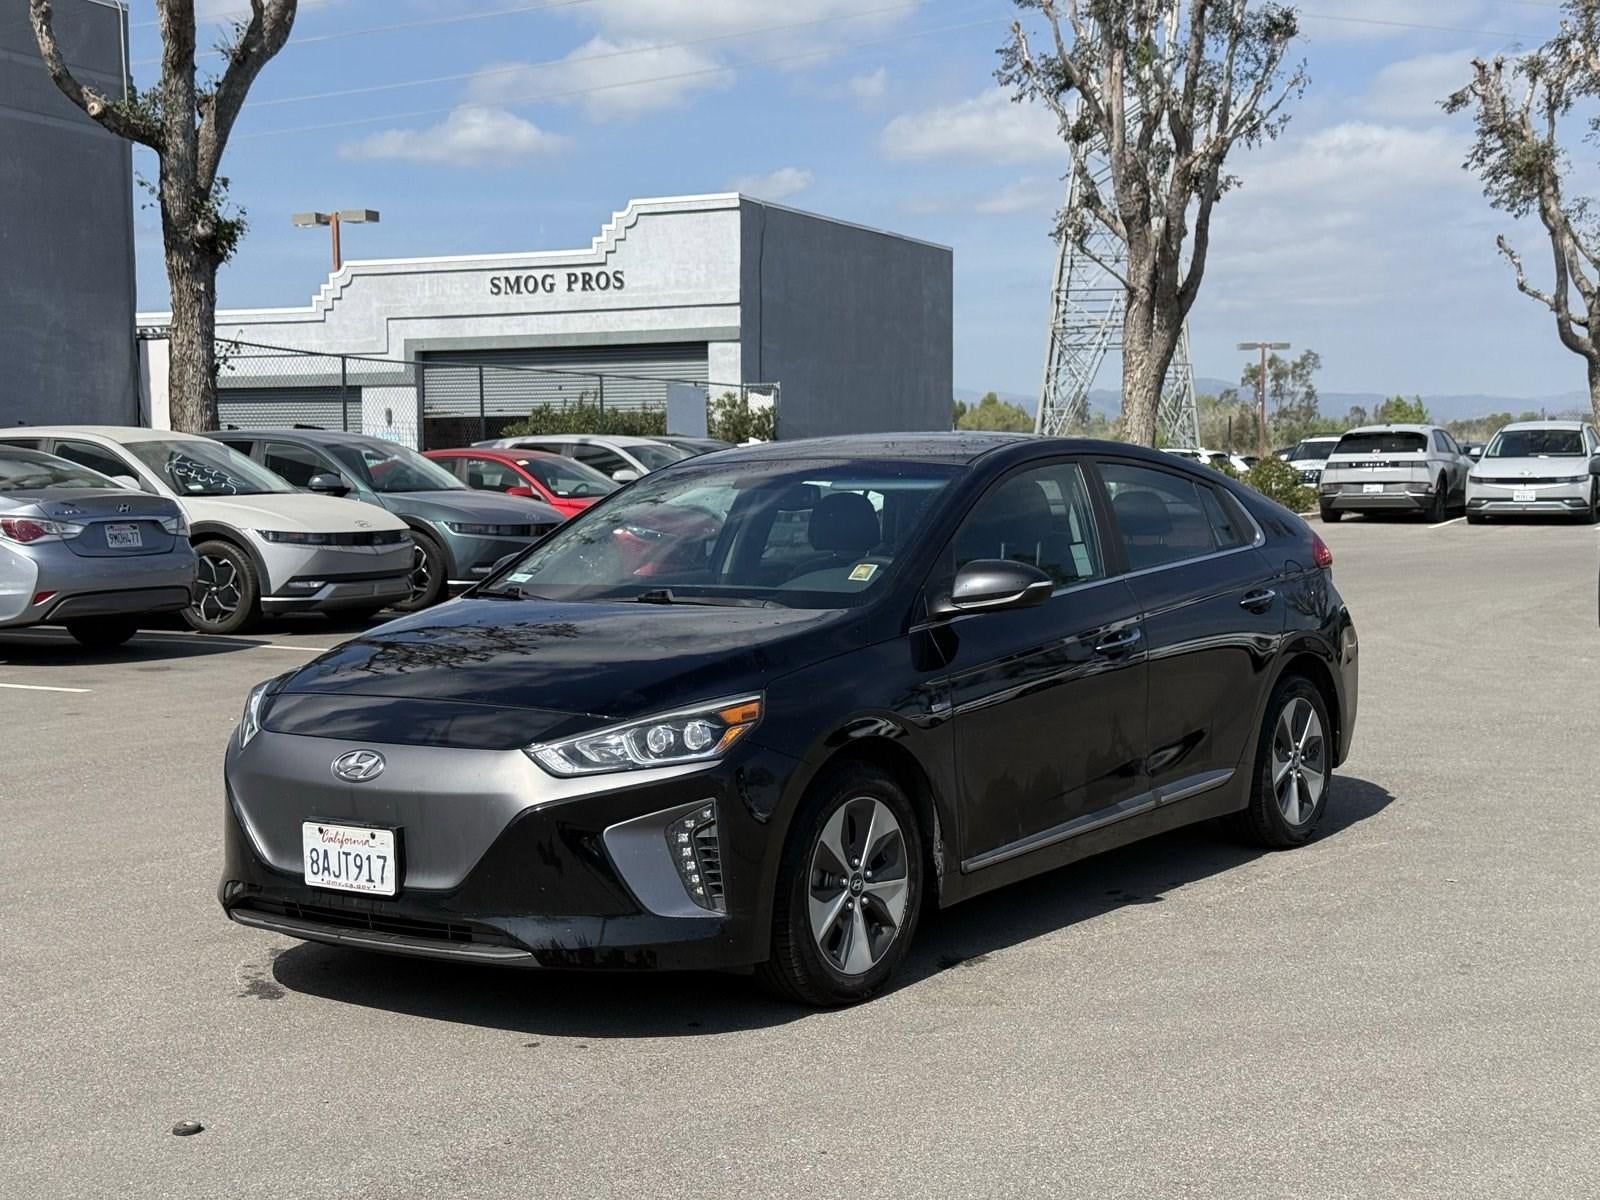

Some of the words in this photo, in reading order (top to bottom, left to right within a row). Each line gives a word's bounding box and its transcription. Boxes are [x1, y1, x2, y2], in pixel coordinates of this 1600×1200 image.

[490, 274, 556, 296] SMOG
[566, 270, 625, 292] PROS
[321, 828, 376, 849] California
[309, 847, 388, 885] 8AJT917
